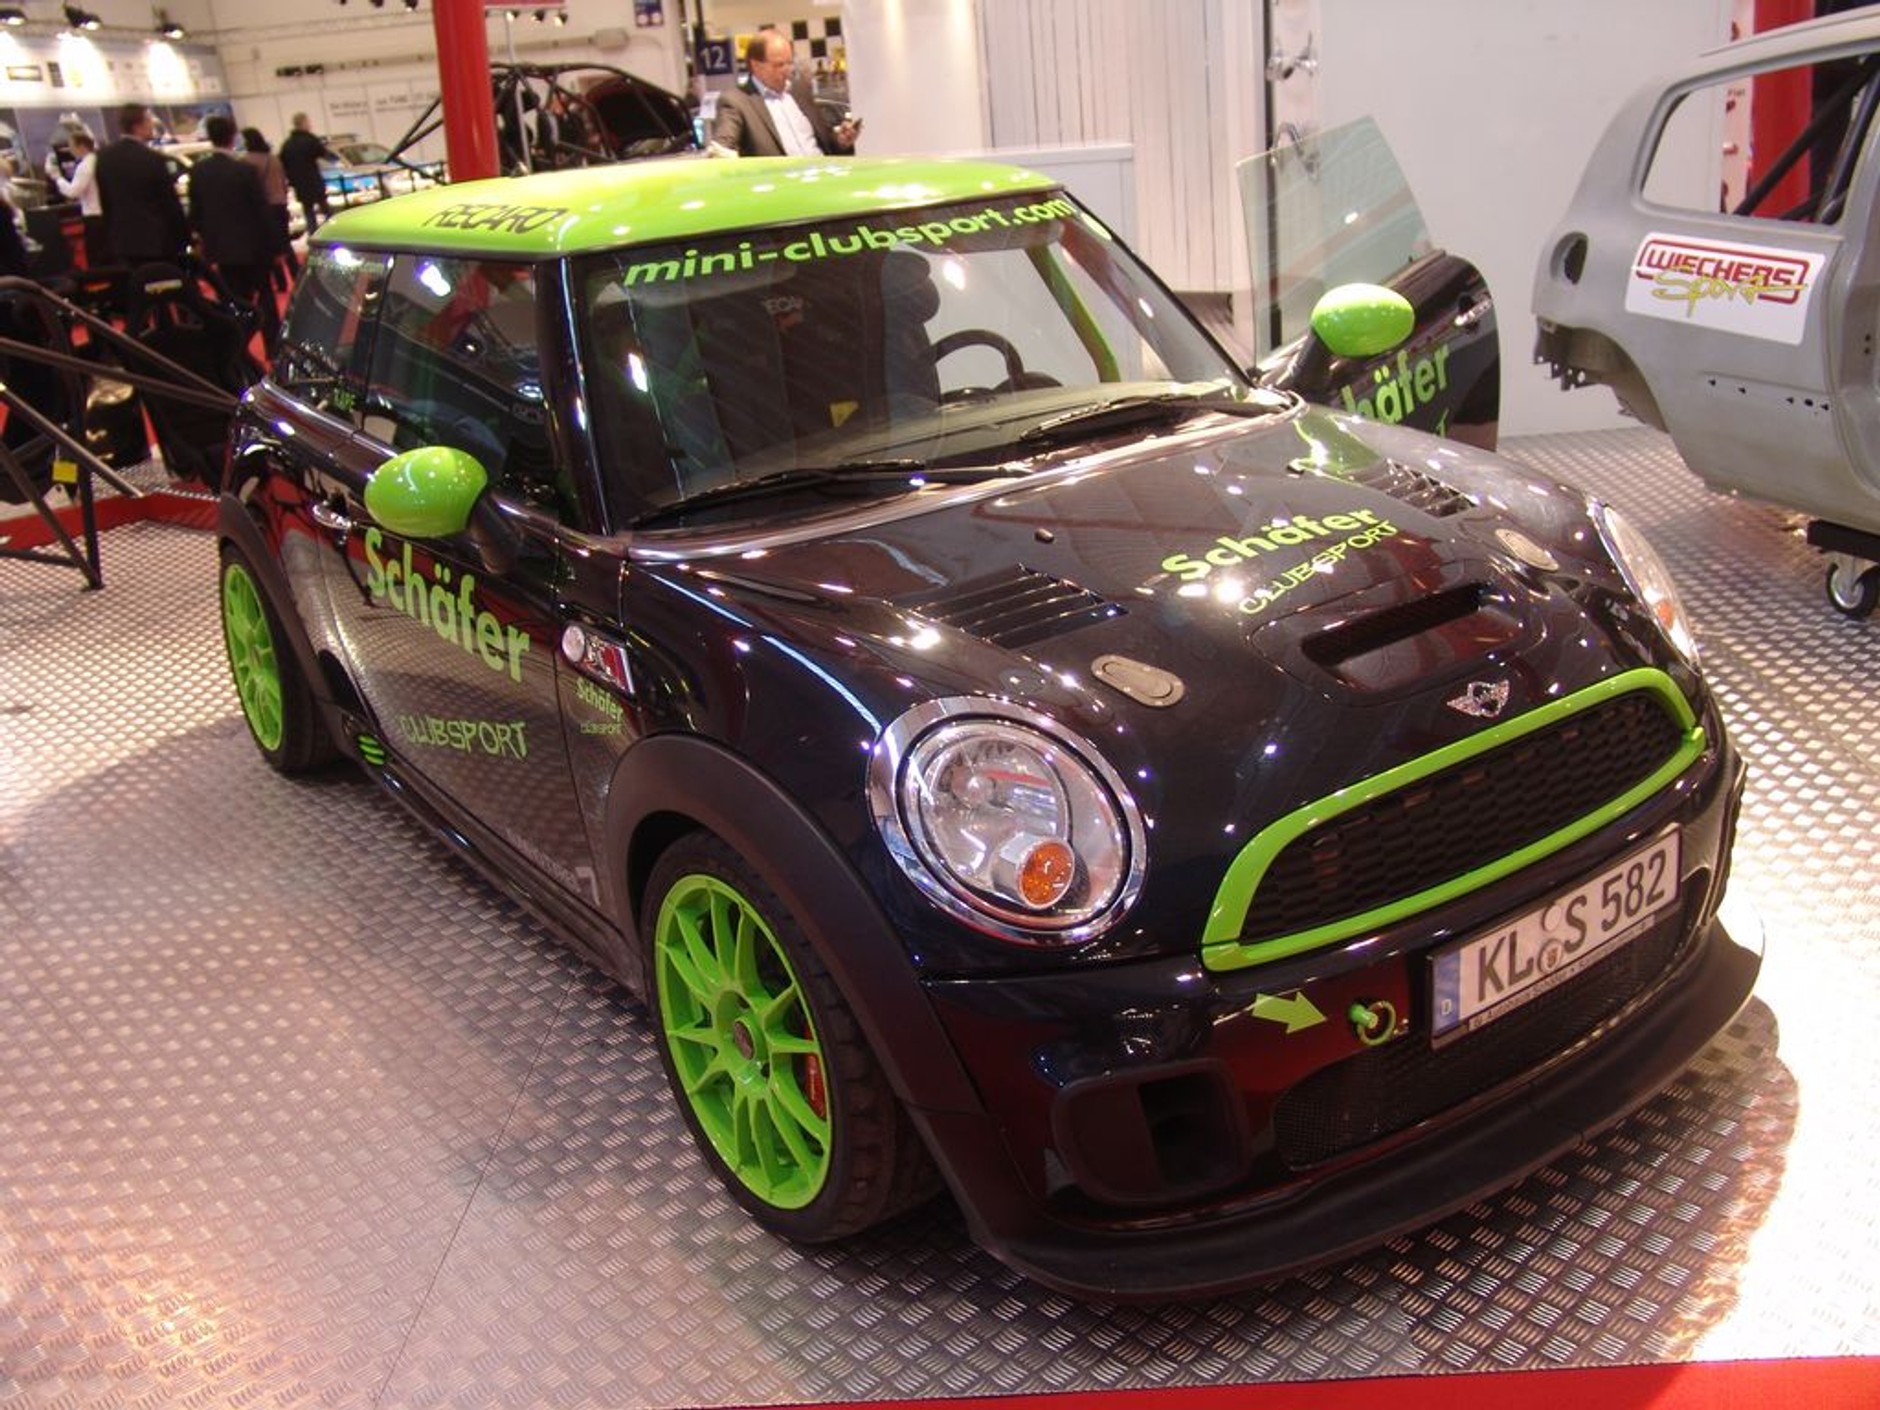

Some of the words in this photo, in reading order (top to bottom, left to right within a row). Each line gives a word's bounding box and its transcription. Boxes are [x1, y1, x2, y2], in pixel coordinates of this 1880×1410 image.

[701, 46, 727, 70] 12
[624, 199, 1077, 286] mini-clubsport.com
[1646, 250, 1794, 288] WIECHERS
[1341, 344, 1449, 423] häfer
[1162, 508, 1378, 580] Schäfer
[1238, 520, 1398, 614] CLUBSPORT
[365, 527, 530, 683] Schäfer
[400, 712, 527, 759] CLUBSPORT
[1478, 930, 1534, 1002] KL
[1564, 895, 1588, 954] S
[1601, 849, 1666, 933] 582
